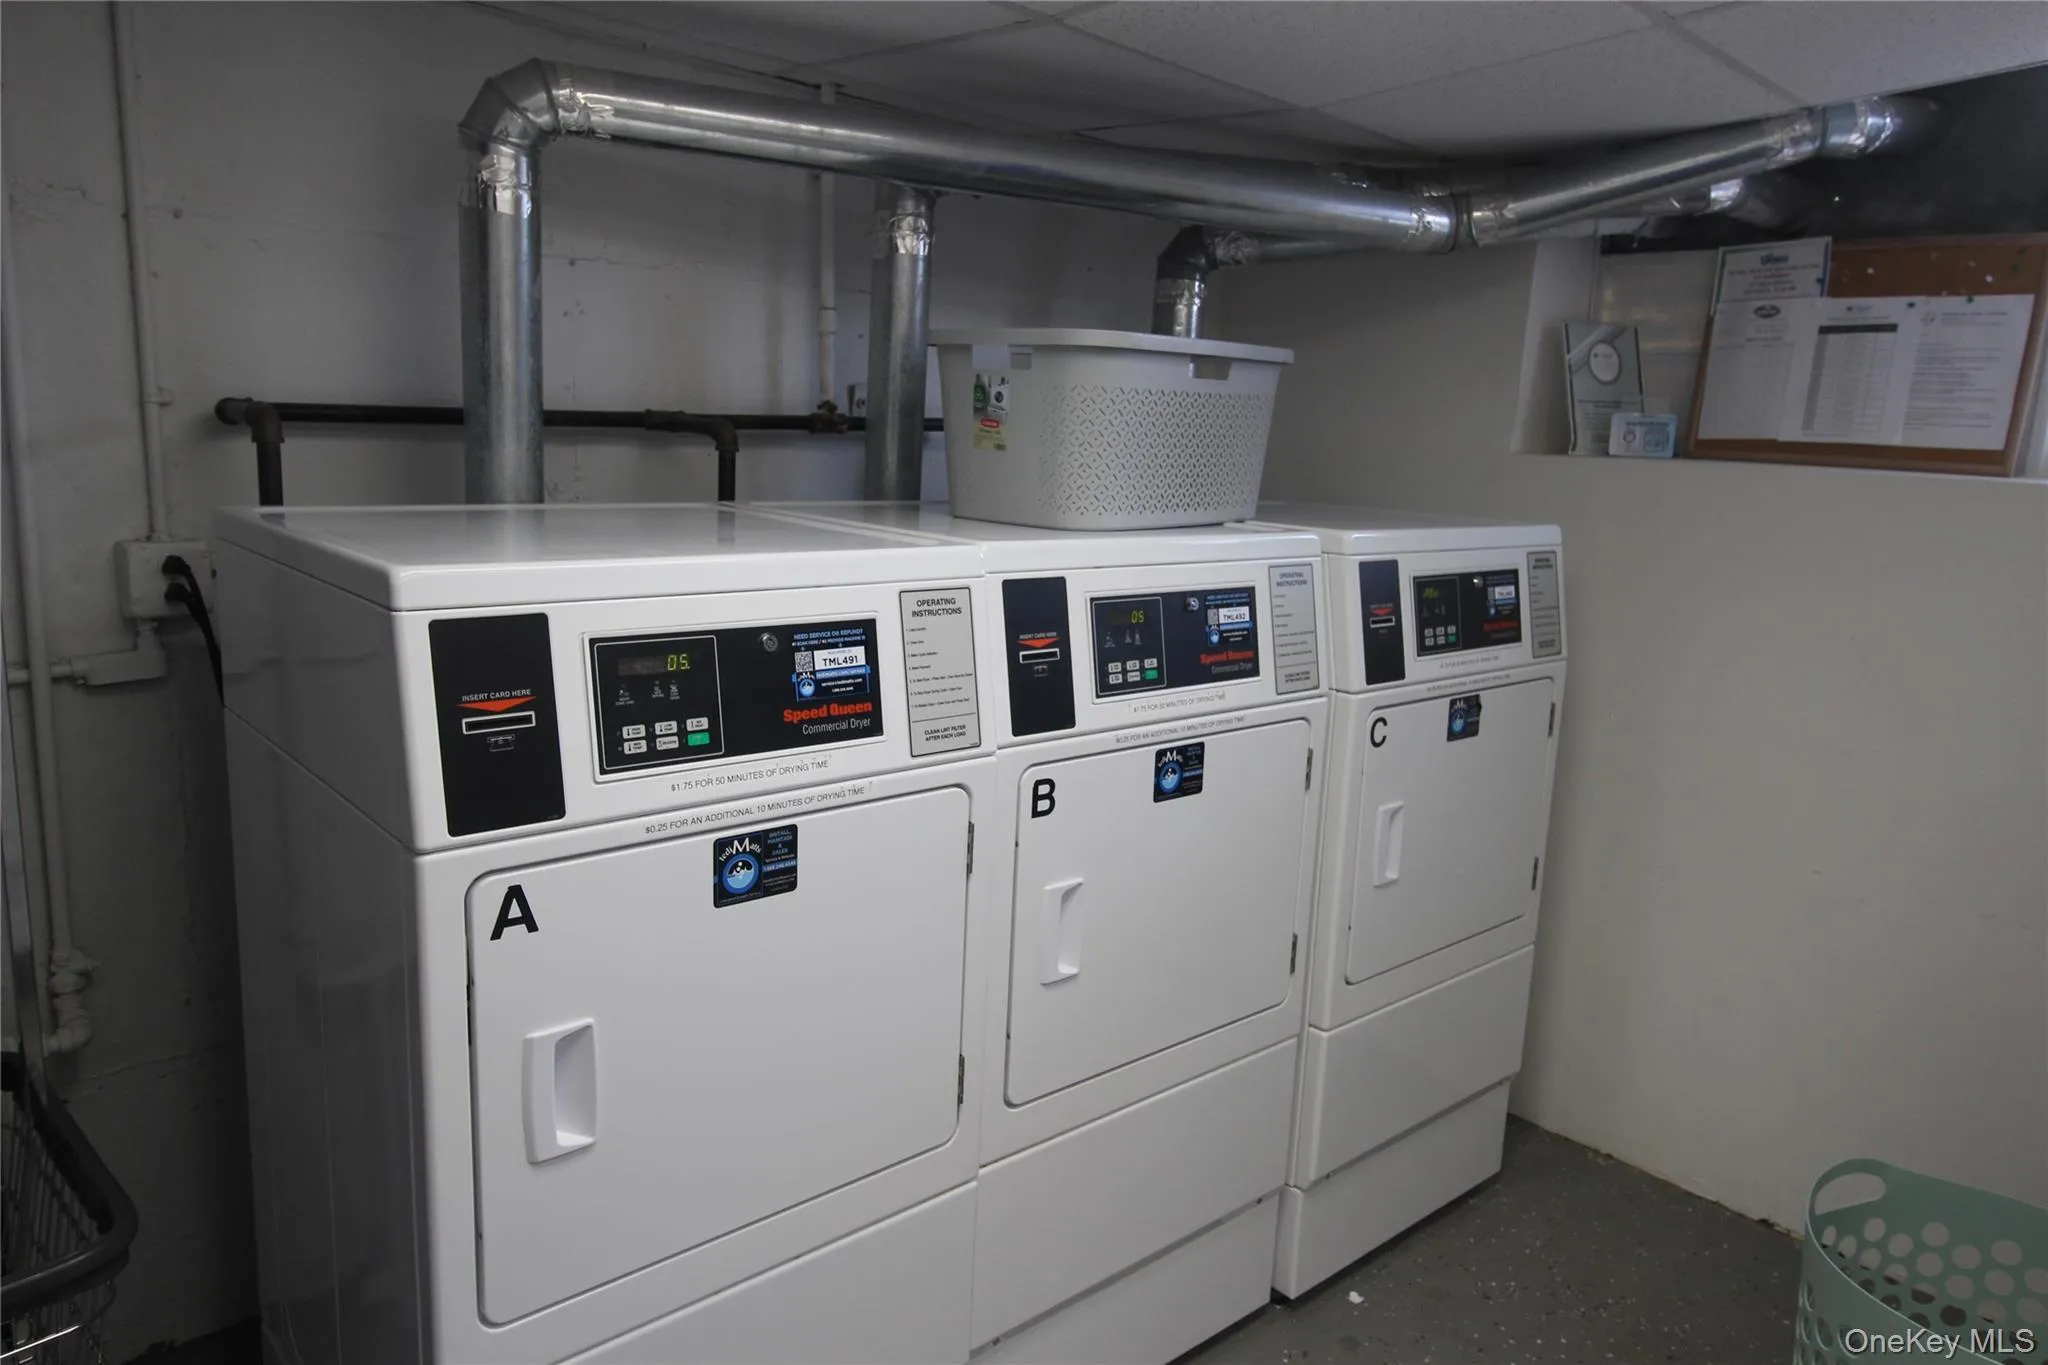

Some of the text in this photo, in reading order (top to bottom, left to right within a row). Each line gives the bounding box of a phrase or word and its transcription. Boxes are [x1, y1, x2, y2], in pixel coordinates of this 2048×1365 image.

[912, 607, 962, 617] INSTRUCTIONS
[916, 598, 956, 607] OPERATING
[822, 655, 858, 667] TML491
[462, 693, 488, 702] INSERT
[490, 691, 510, 699] CARD
[783, 702, 872, 723] Speed Queen
[802, 718, 871, 735] Commercial Dryer
[1370, 717, 1388, 748] C
[695, 778, 713, 789] FOR
[715, 776, 726, 785] 50
[727, 771, 764, 783] MINUTES
[766, 769, 778, 778] OF
[779, 763, 809, 776] DRYING
[811, 760, 829, 770] TIME
[1031, 778, 1056, 818] B
[645, 824, 668, 834] $0.25
[670, 820, 689, 829] FOR
[691, 817, 703, 825] AN
[704, 808, 753, 823] ADDITIONAL
[767, 799, 802, 811] MINUTES
[804, 796, 816, 805] OF
[817, 790, 846, 802] DRYING
[848, 787, 865, 796] TIME
[490, 884, 539, 941] A
